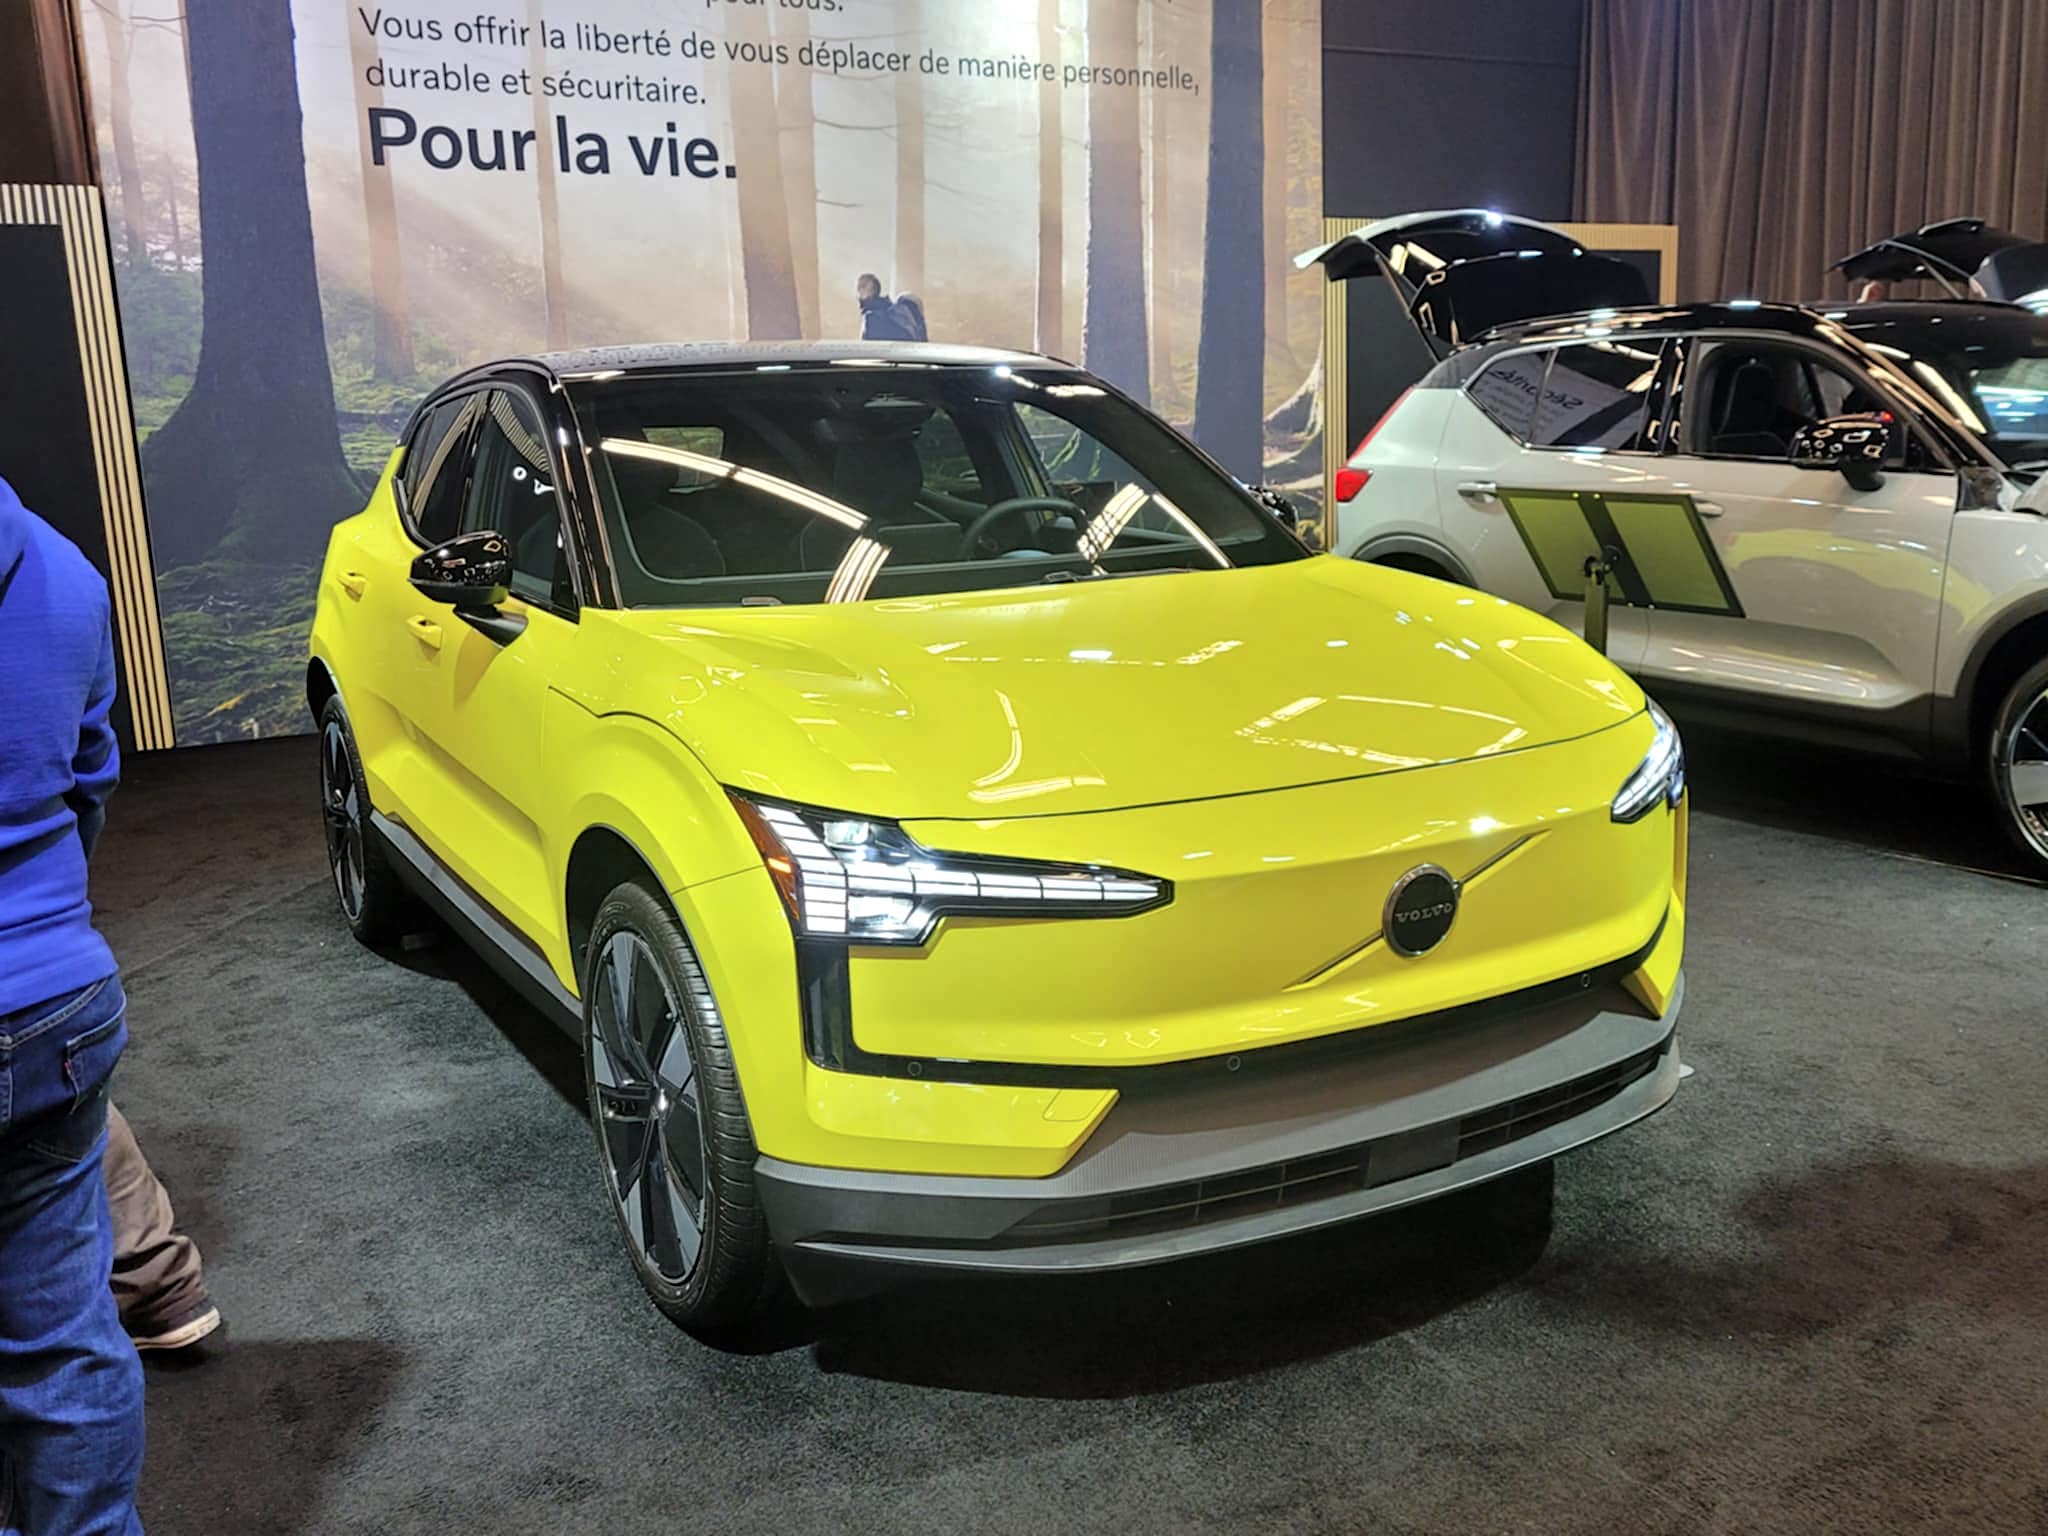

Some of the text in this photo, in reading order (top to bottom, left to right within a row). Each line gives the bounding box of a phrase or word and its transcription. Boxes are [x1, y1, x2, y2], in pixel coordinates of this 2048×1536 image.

[357, 7, 1199, 96] Vous offrir la liberté de vous déplacer de manière personnelle,
[365, 58, 707, 105] durable et sécuritaire.
[367, 106, 737, 179] Pour la vie.
[1395, 903, 1453, 922] VOLVO
